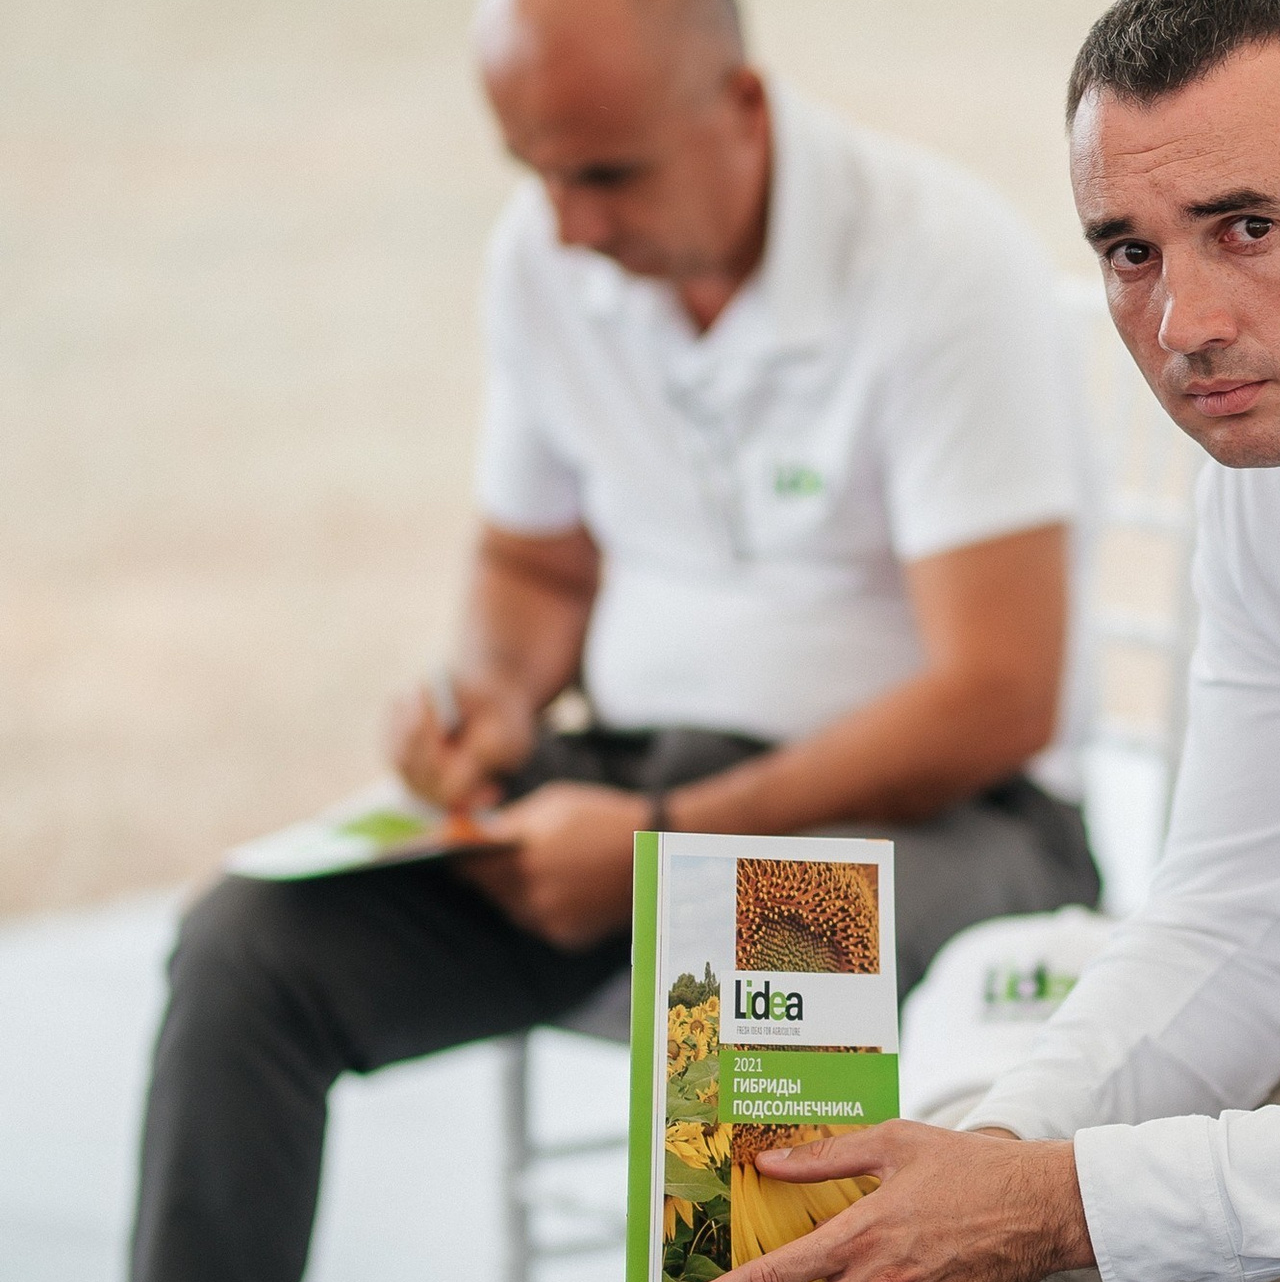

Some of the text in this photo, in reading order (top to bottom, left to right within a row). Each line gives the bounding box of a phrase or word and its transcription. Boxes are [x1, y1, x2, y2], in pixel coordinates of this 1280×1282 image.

[735, 979, 804, 1021] Lidea
[751, 1026, 763, 1035] IDEAS
[772, 1027, 801, 1037] AGRICULTURE
[734, 1057, 762, 1072] 2021
[733, 1078, 801, 1097] ГИБРИДЫ
[733, 1100, 864, 1119] ПОДСОЛНЕЧНИКА
